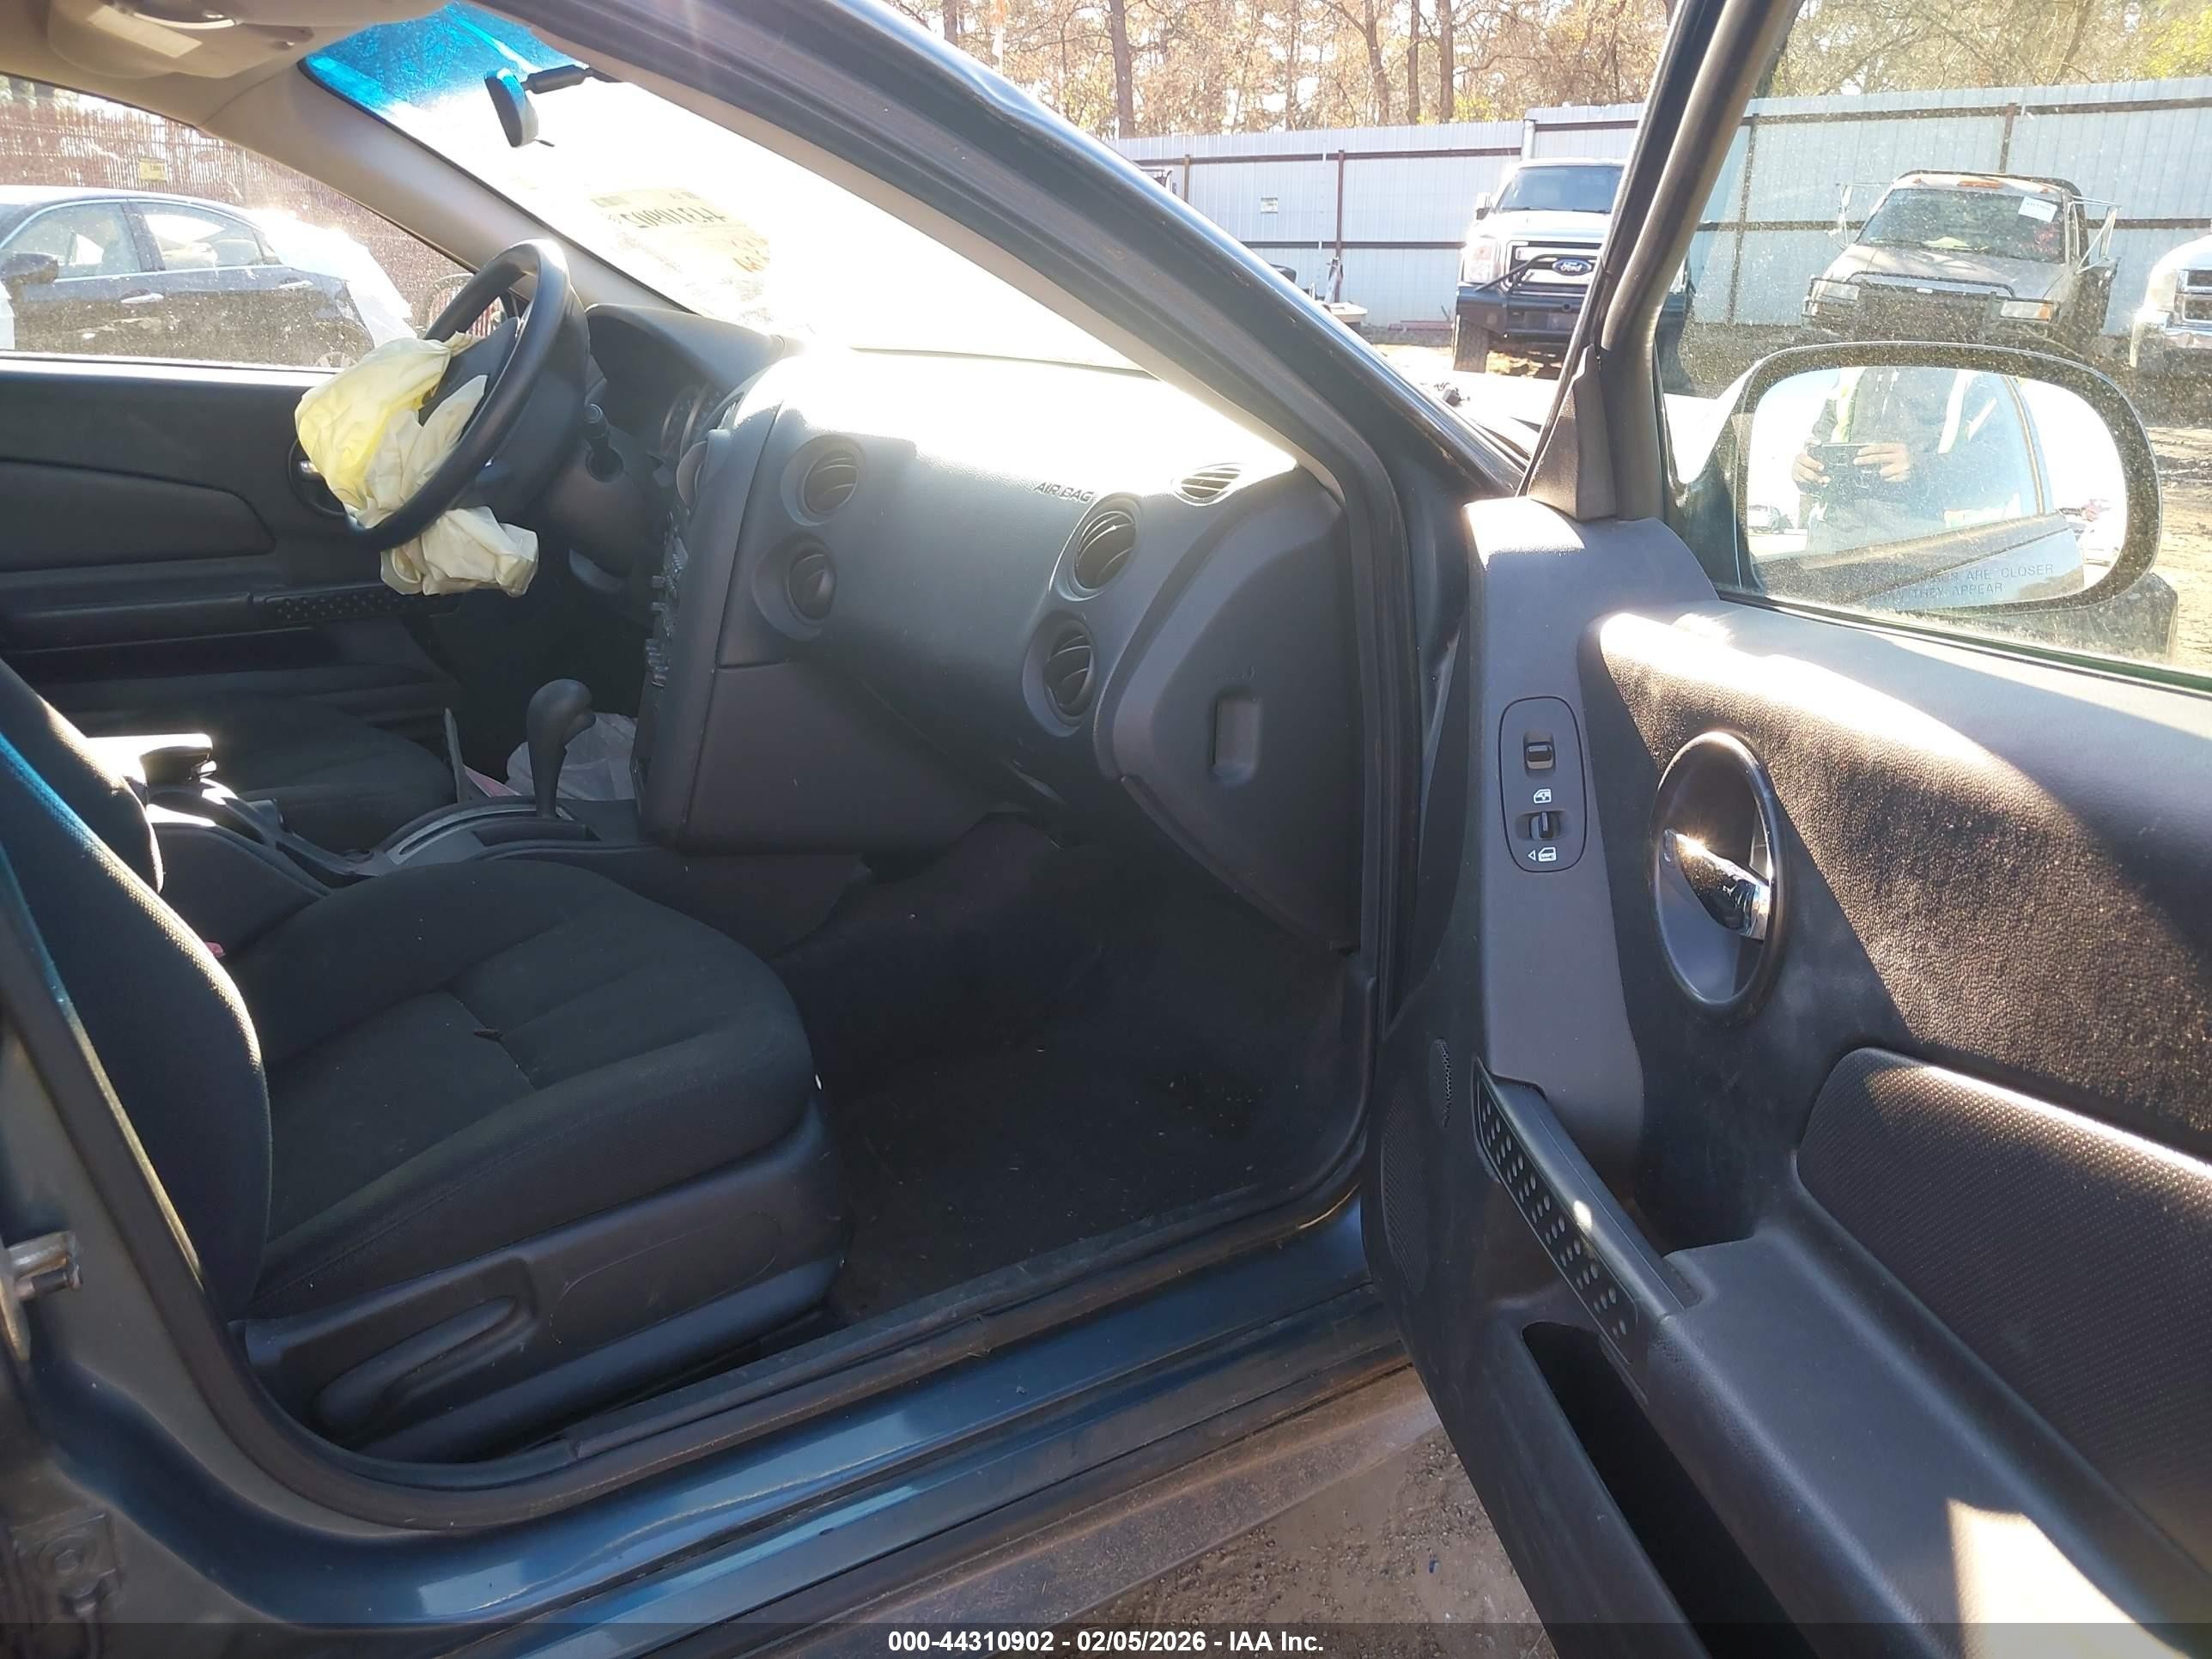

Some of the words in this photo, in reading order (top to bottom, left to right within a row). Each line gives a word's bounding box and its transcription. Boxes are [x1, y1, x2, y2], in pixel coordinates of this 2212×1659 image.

[1033, 481, 1061, 495] AIR
[1059, 487, 1095, 502] BAG
[1966, 568, 1992, 580] ARE
[2001, 563, 2054, 579] CLOSER
[1913, 586, 1944, 599] THEY
[1953, 582, 2003, 596] APPEAR
